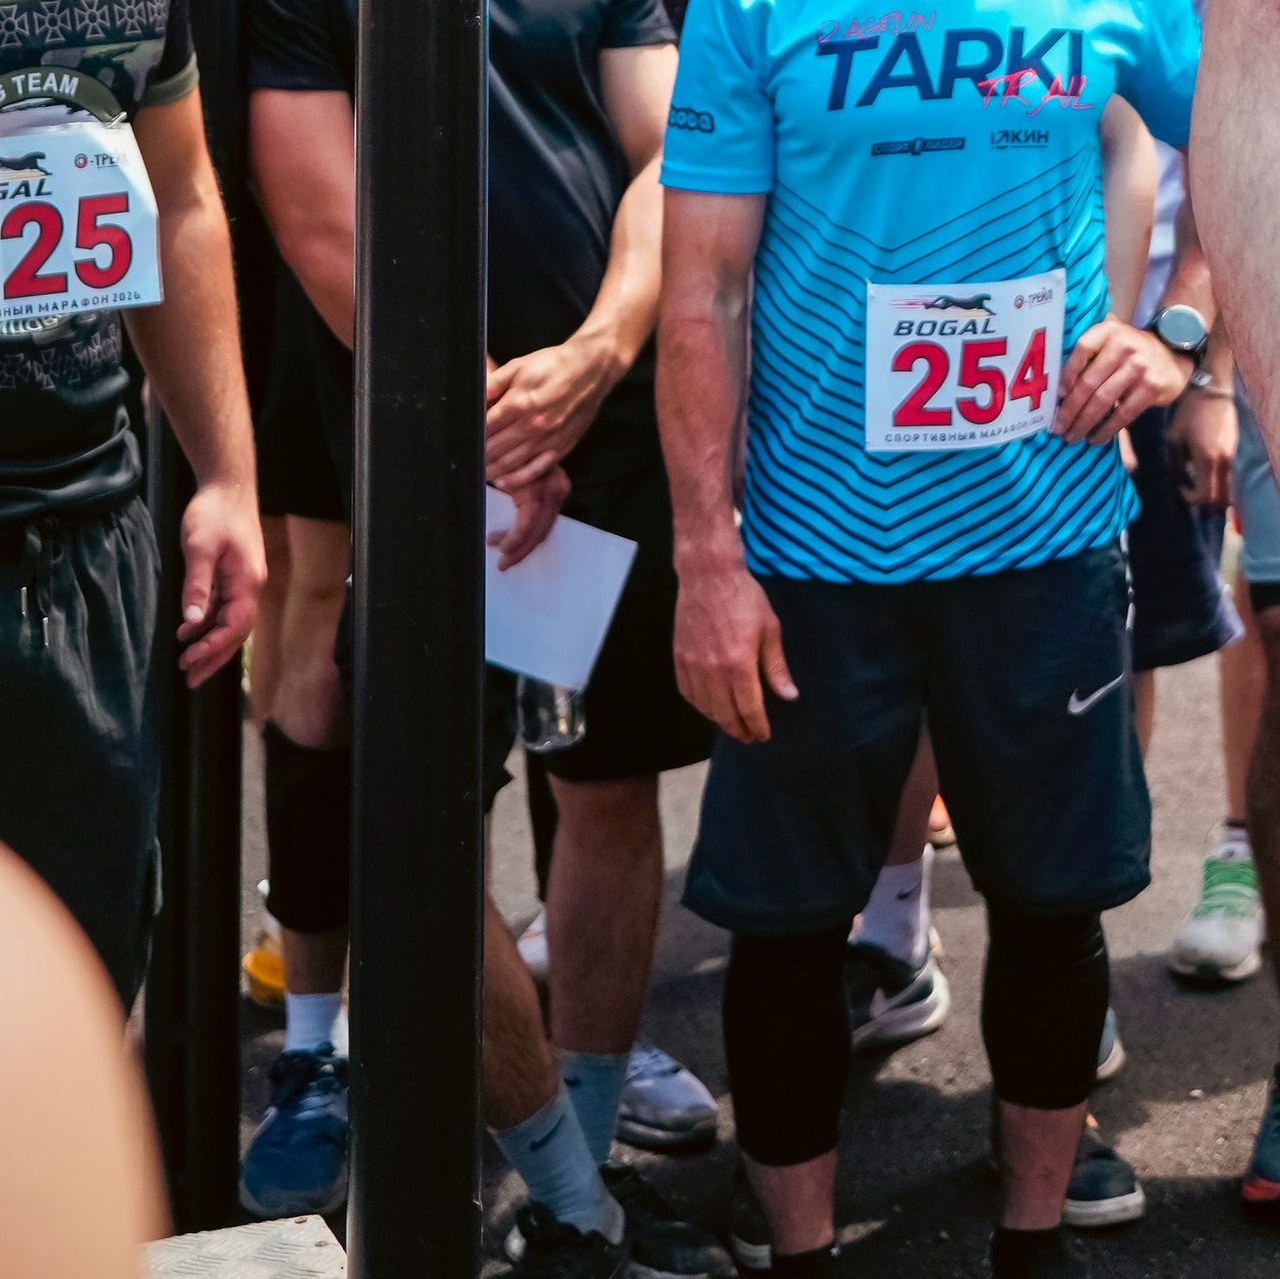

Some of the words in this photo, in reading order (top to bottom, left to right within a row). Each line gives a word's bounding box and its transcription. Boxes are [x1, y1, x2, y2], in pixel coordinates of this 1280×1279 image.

[12, 72, 79, 96] TEAM
[815, 26, 1084, 112] TARKI
[977, 68, 1094, 116] TRAIL
[0, 191, 133, 300] 25
[0, 304, 34, 318] НЫЙ
[38, 294, 109, 313] МАРАФОН
[893, 318, 997, 337] BOGAL
[891, 326, 1049, 427] 254
